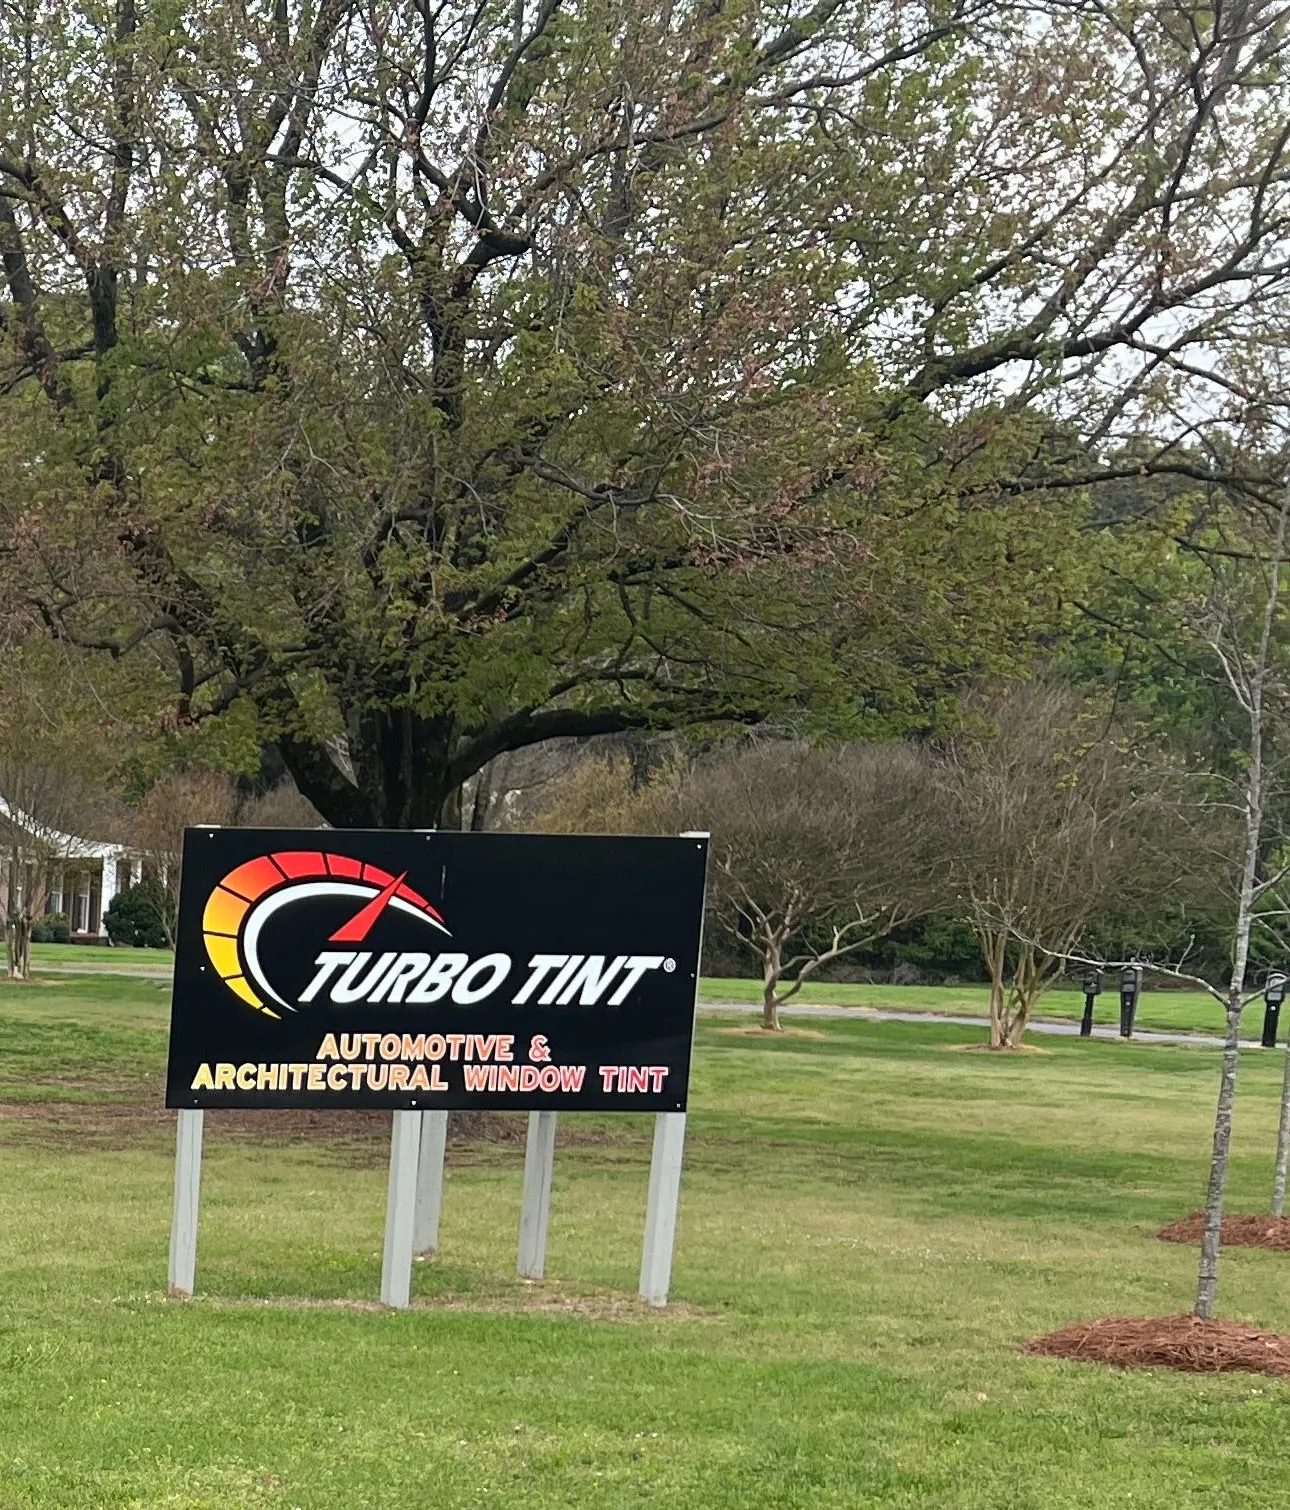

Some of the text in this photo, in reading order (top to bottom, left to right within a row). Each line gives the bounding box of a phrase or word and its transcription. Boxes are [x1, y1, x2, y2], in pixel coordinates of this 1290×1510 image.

[298, 951, 511, 1006] TURBO
[316, 1033, 552, 1062] AUTOMOTIVE &
[191, 1062, 669, 1094] ARCHITECTURAL WINDOW TINT
